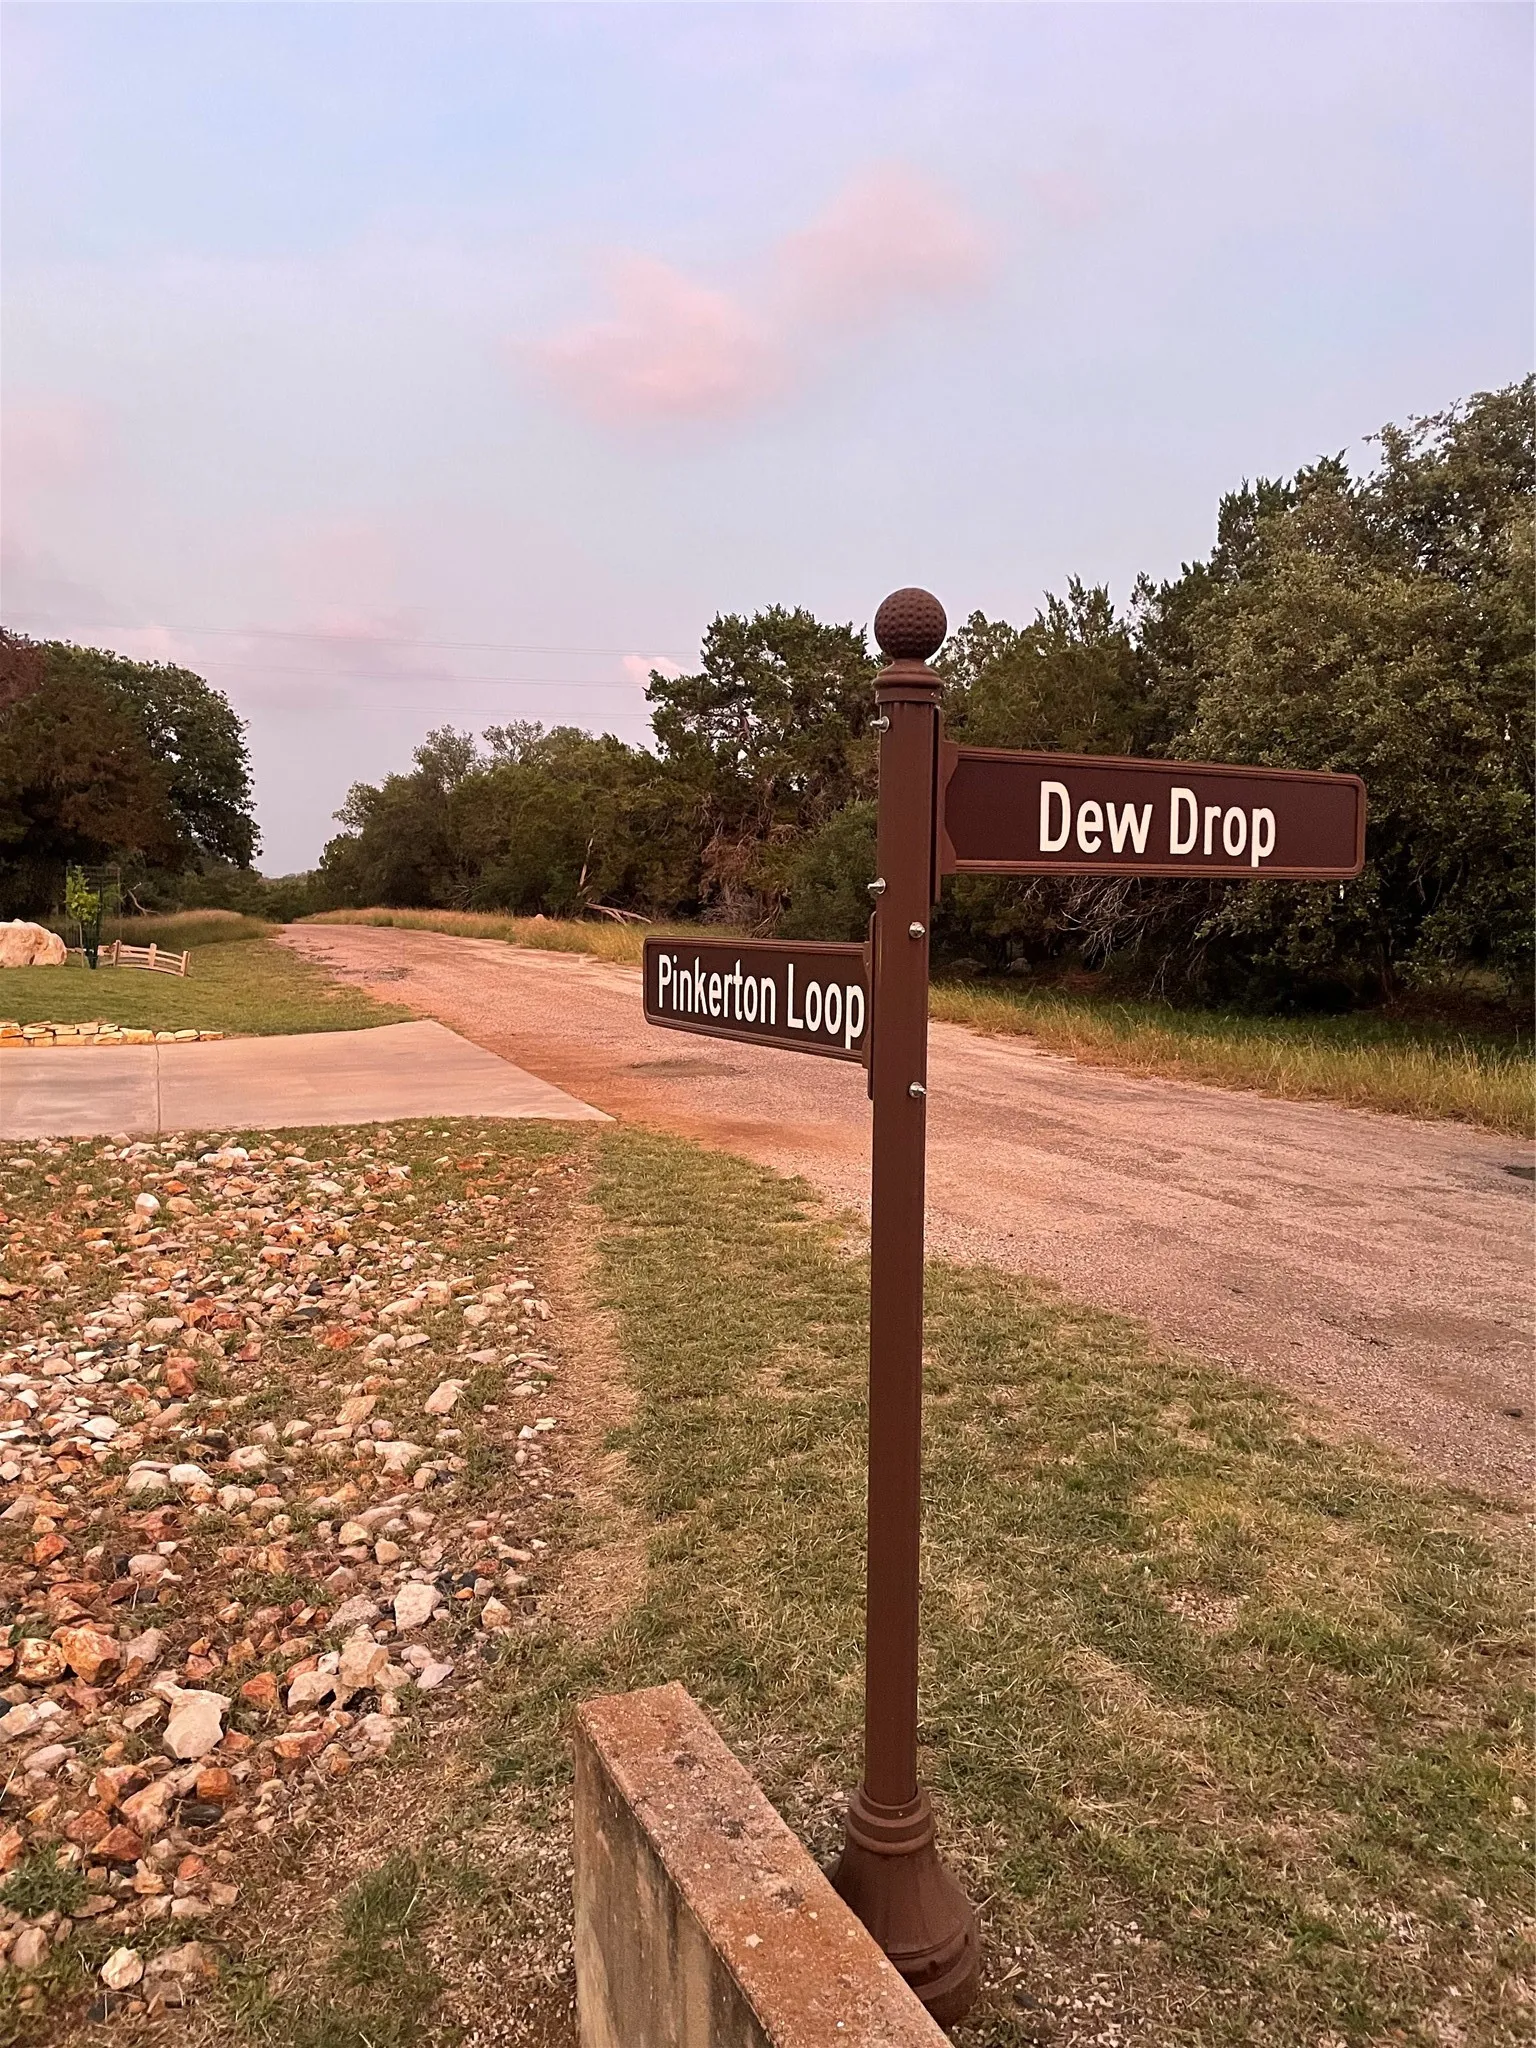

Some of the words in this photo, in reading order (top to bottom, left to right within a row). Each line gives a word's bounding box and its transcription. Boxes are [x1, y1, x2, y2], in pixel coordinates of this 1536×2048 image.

[1039, 780, 1153, 854] Dew
[1169, 787, 1276, 868] Drop
[658, 954, 776, 1025] Pinkerton
[787, 963, 865, 1050] Loop
